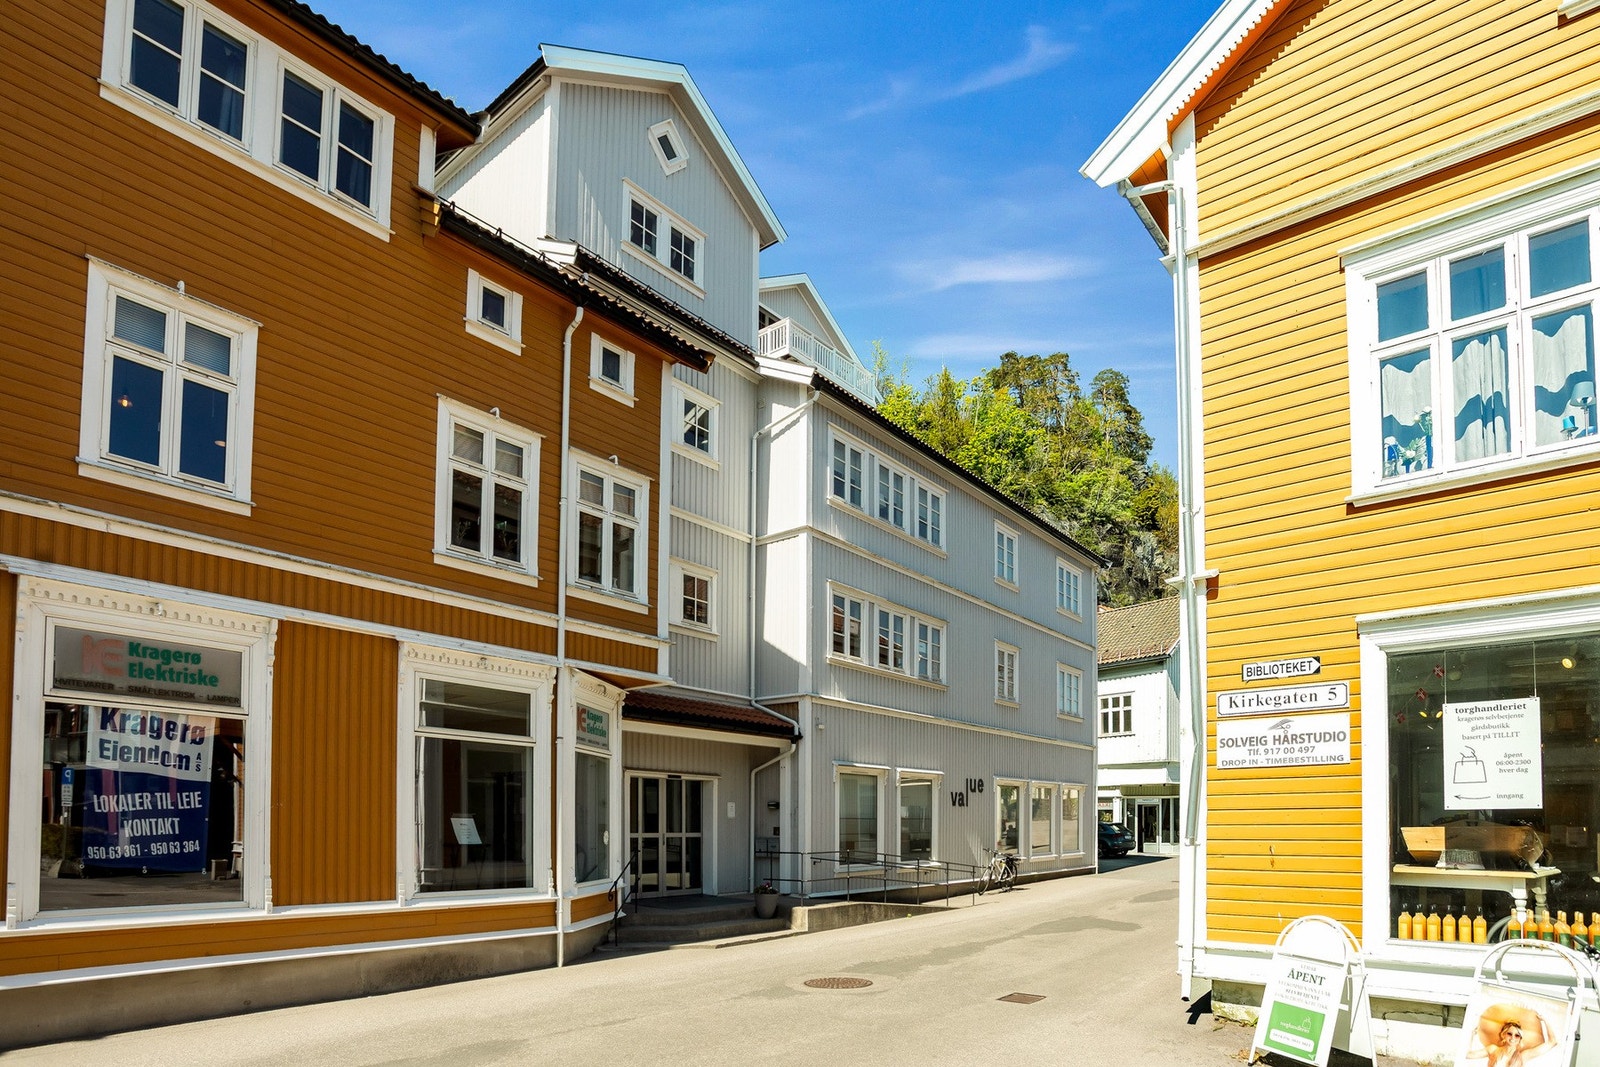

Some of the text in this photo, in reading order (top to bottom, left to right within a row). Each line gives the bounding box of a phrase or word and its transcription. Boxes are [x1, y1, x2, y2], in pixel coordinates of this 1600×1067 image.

[128, 641, 202, 666] Kragerø
[128, 662, 219, 687] Elektriske
[1246, 660, 1313, 677] BIBLIOTEKET
[55, 678, 115, 691] HVITEVARER
[128, 684, 196, 699] SMÅELEKTRISK
[207, 694, 240, 704] LAMPER
[1229, 687, 1337, 708] Kirkegaten 5
[1454, 703, 1527, 715] torghandleriet
[100, 707, 206, 746] Kragerø
[1482, 733, 1491, 741] på
[1492, 731, 1521, 739] TILLIT
[1219, 730, 1347, 749] SOLVEIG HÅRSTUDIO
[98, 738, 191, 771] Eiendom
[1221, 759, 1246, 767] DROP
[1265, 754, 1344, 765] TIMEBESTILLING
[1247, 746, 1316, 756] Tlf. 917 00 497
[1503, 751, 1523, 759] åpent
[1516, 766, 1529, 774] dag
[93, 791, 153, 813] LOKALER
[154, 792, 175, 810] TIL
[177, 791, 203, 810] LEIE
[950, 778, 985, 807] value
[123, 817, 180, 838] KONTAKT
[87, 846, 106, 860] 950
[109, 845, 122, 860] 63
[124, 843, 141, 858] 361
[150, 841, 168, 856] 950
[169, 841, 180, 854] 63
[182, 839, 200, 853] 364
[1287, 967, 1326, 986] ÅPENT
